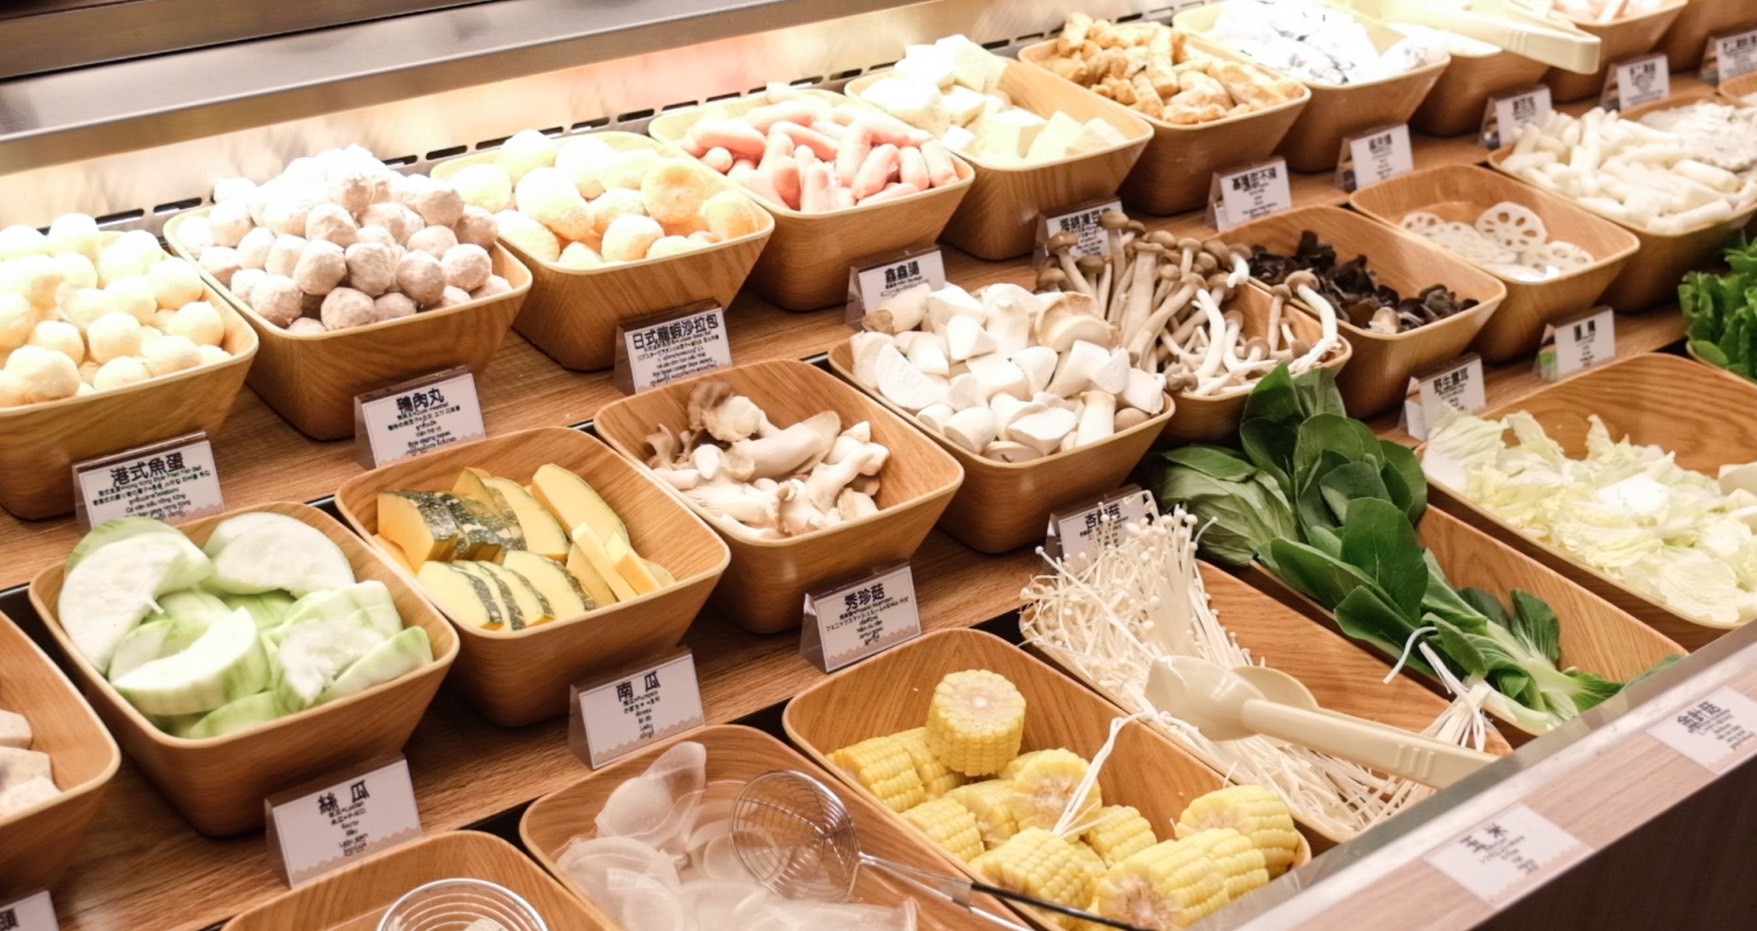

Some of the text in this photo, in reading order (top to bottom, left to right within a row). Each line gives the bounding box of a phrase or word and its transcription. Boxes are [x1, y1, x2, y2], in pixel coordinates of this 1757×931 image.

[632, 313, 719, 350] 日式龍蝦沙拉包
[396, 387, 444, 413] 鴨肉丸
[110, 451, 185, 487] 港式魚蛋
[844, 582, 885, 612] 秀珍菇
